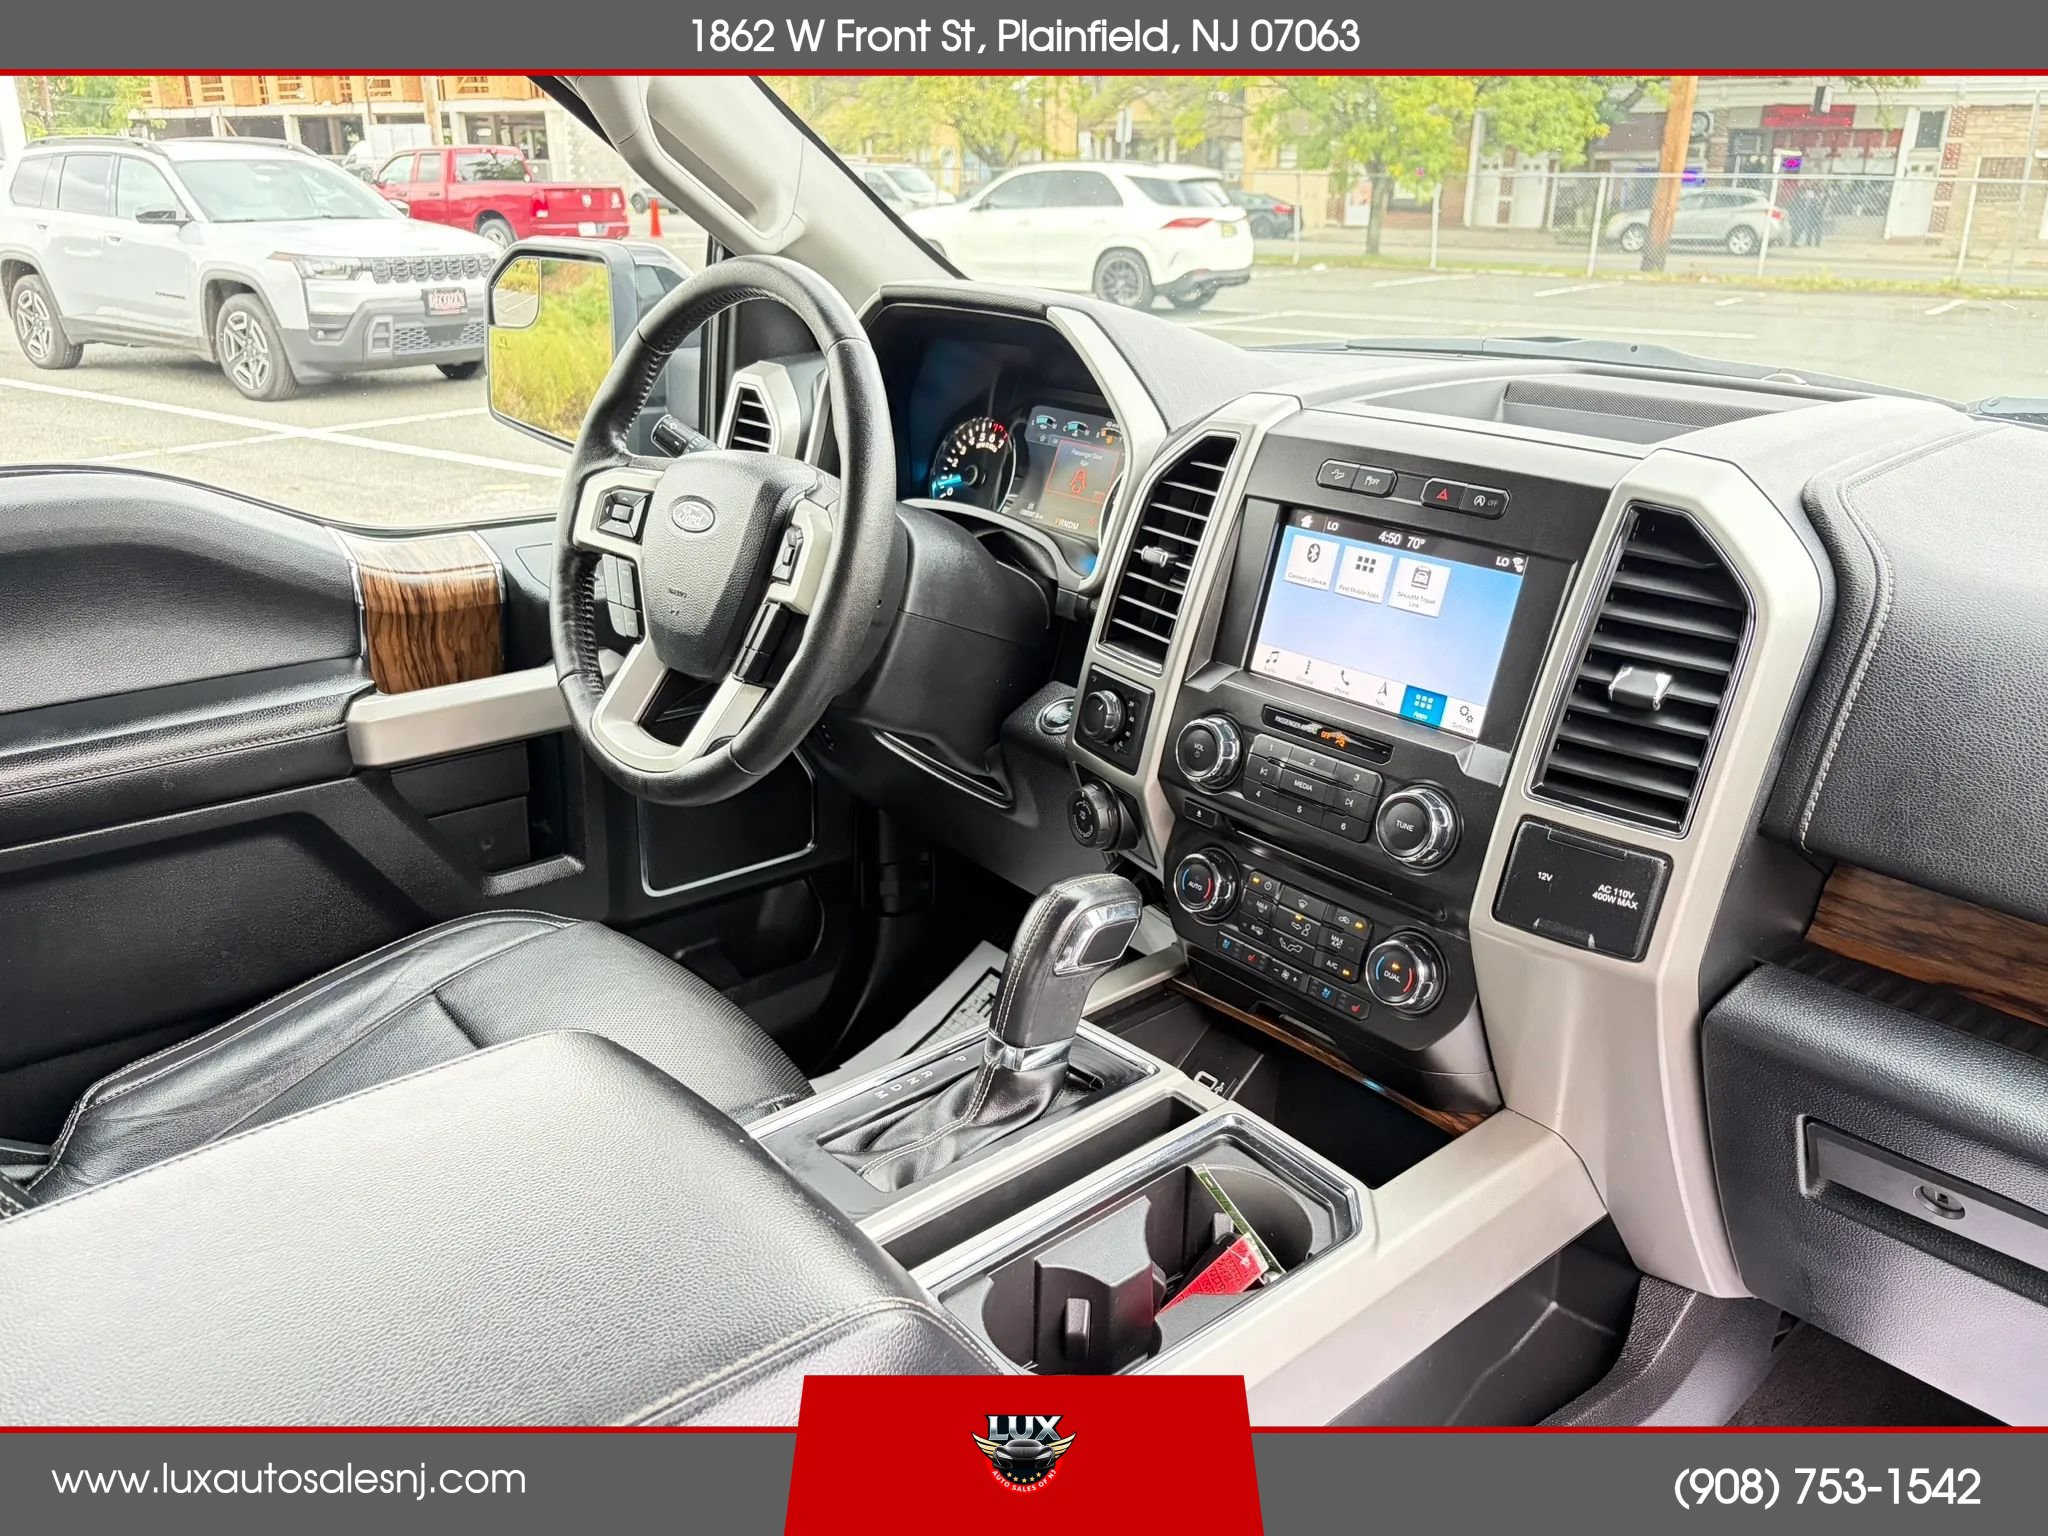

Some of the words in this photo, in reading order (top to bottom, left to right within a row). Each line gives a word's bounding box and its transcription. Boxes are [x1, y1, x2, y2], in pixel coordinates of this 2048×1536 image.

[1326, 520, 1340, 532] LO
[1378, 530, 1401, 546] 4:50
[1495, 556, 1510, 568] LO
[1412, 711, 1428, 721] Apps
[1353, 773, 1360, 781] 3
[1293, 779, 1313, 792] MEDIA
[1340, 822, 1347, 831] 6
[1395, 819, 1415, 832] TUNE
[1537, 871, 1554, 882] 12V
[1188, 880, 1203, 892] AUTO
[1598, 884, 1612, 894] AC
[1614, 887, 1636, 900] 110V
[1592, 892, 1617, 905] 400W
[1617, 897, 1639, 910] MAX
[1331, 933, 1345, 945] MAX
[1326, 959, 1338, 971] A/C
[1383, 969, 1401, 983] DUAL
